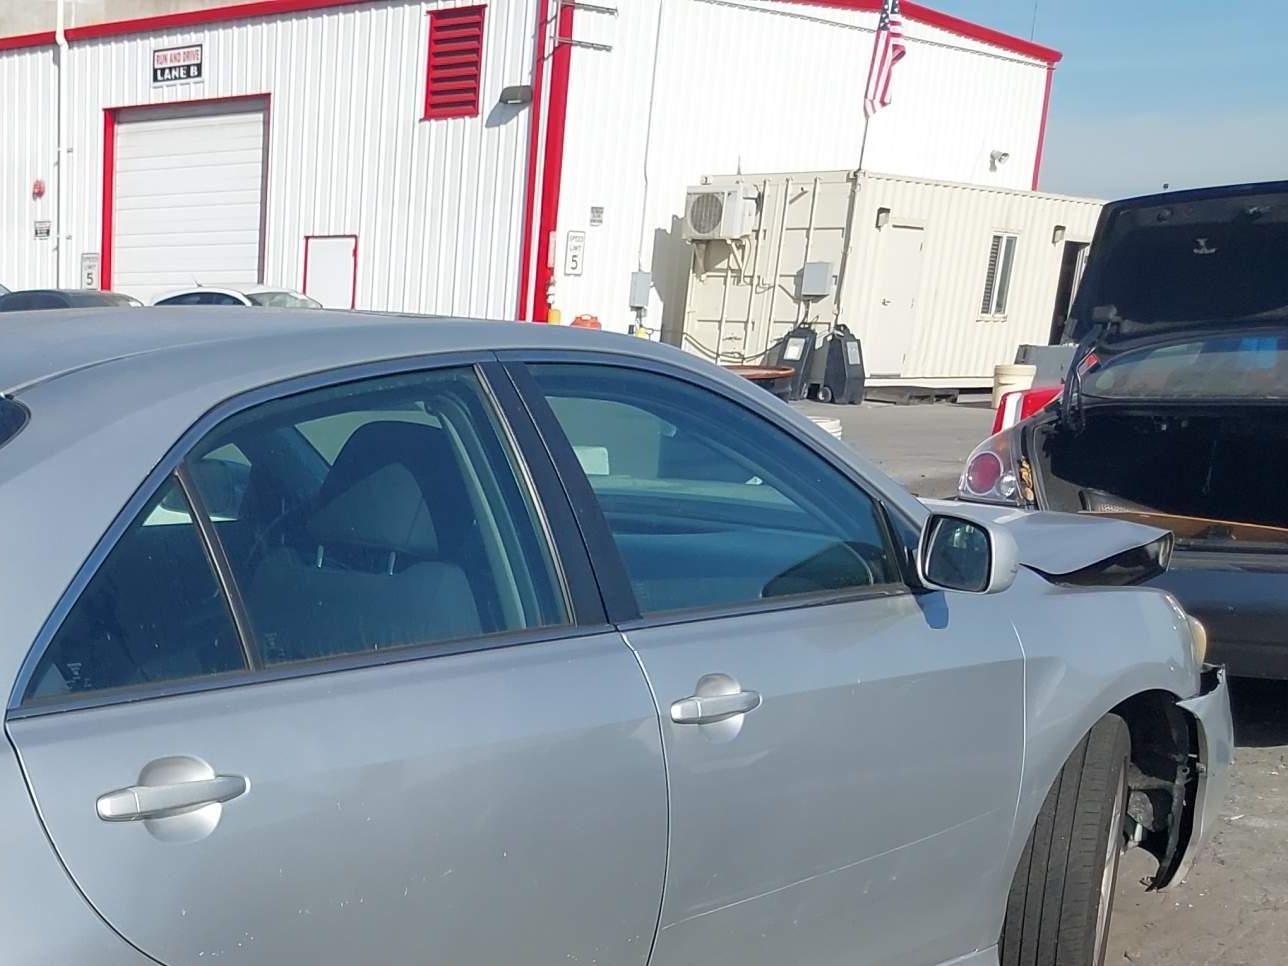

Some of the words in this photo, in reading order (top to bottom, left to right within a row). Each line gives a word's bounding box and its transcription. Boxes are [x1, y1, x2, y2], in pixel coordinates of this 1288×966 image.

[156, 53, 169, 65] RUN
[170, 51, 181, 63] AND
[182, 49, 200, 62] DRIVE
[156, 66, 187, 81] LANE
[189, 65, 198, 77] B
[570, 254, 579, 271] 5
[86, 272, 94, 286] 5
